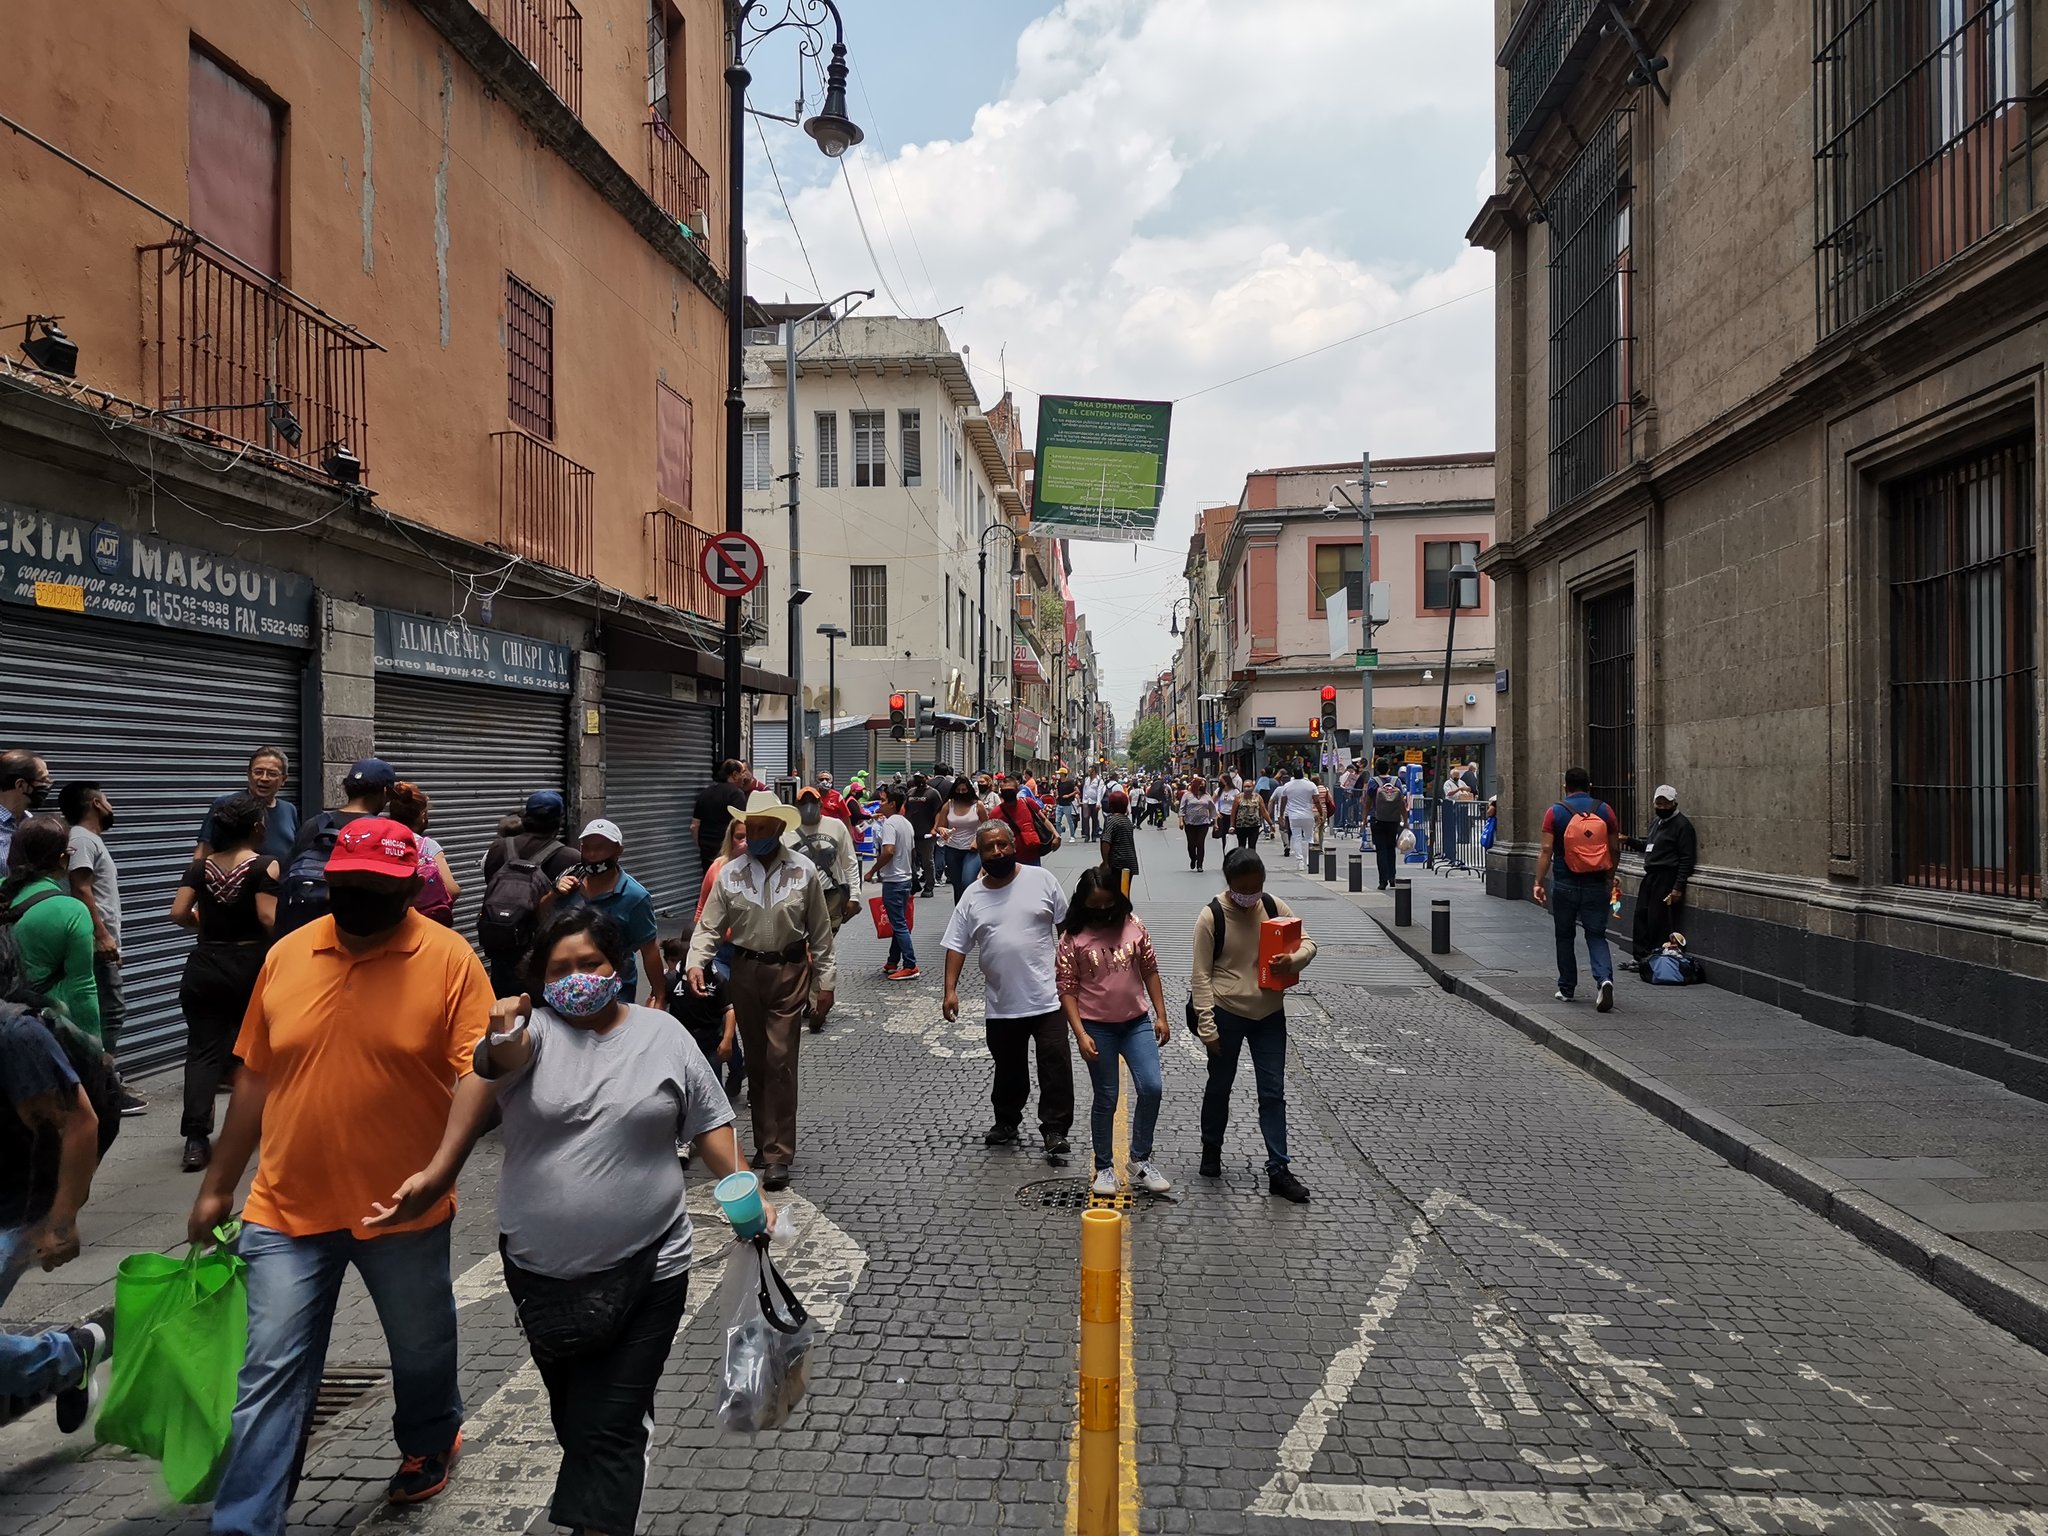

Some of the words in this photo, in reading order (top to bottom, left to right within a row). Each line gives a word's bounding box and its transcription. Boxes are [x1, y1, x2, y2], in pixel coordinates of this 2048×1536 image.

[1080, 409, 1110, 417] CENTRO
[1095, 402, 1136, 411] DISTANCIA
[96, 537, 119, 556] ADT
[18, 565, 61, 584] CORREO
[64, 574, 106, 593] MAYOR
[109, 582, 137, 598] 42-A
[182, 595, 230, 615] 42-4938
[182, 610, 230, 630] 22-5443
[235, 606, 260, 635] FAX.
[260, 617, 310, 639] 5522-4958
[399, 621, 489, 662] ALMACENES
[374, 655, 421, 670] Correo
[673, 980, 685, 996] 4
